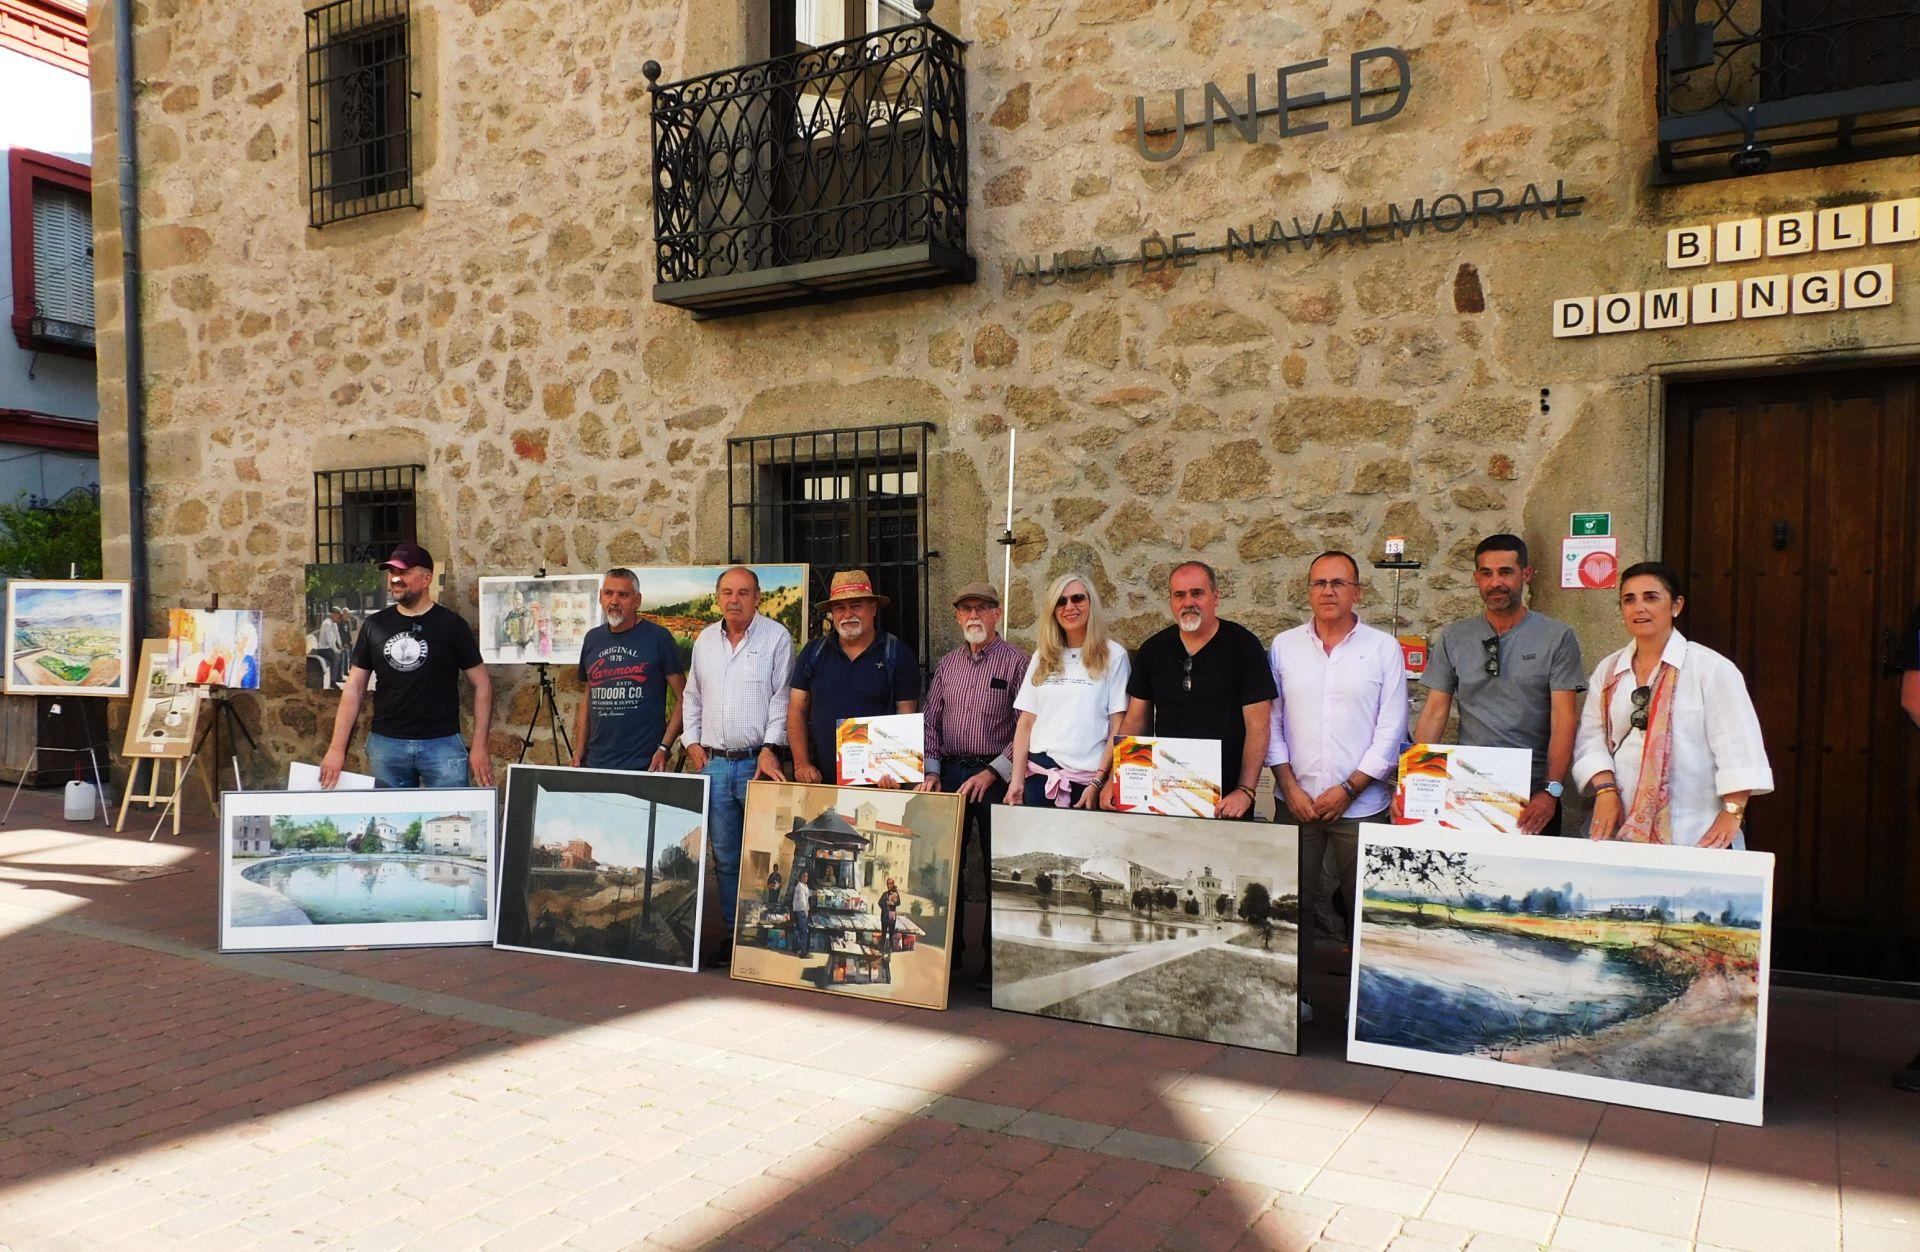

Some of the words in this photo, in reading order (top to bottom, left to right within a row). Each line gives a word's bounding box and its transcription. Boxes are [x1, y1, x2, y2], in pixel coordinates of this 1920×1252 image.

[1135, 46, 1411, 162] UNED
[1008, 245, 1115, 291] AULA
[1140, 231, 1198, 274] DE
[1226, 179, 1583, 263] NAVALMORAL
[1562, 270, 1882, 328] DOMINGO
[1387, 543, 1400, 552] 13
[384, 632, 411, 655] DANIEL
[598, 646, 640, 658] ORIGINAL
